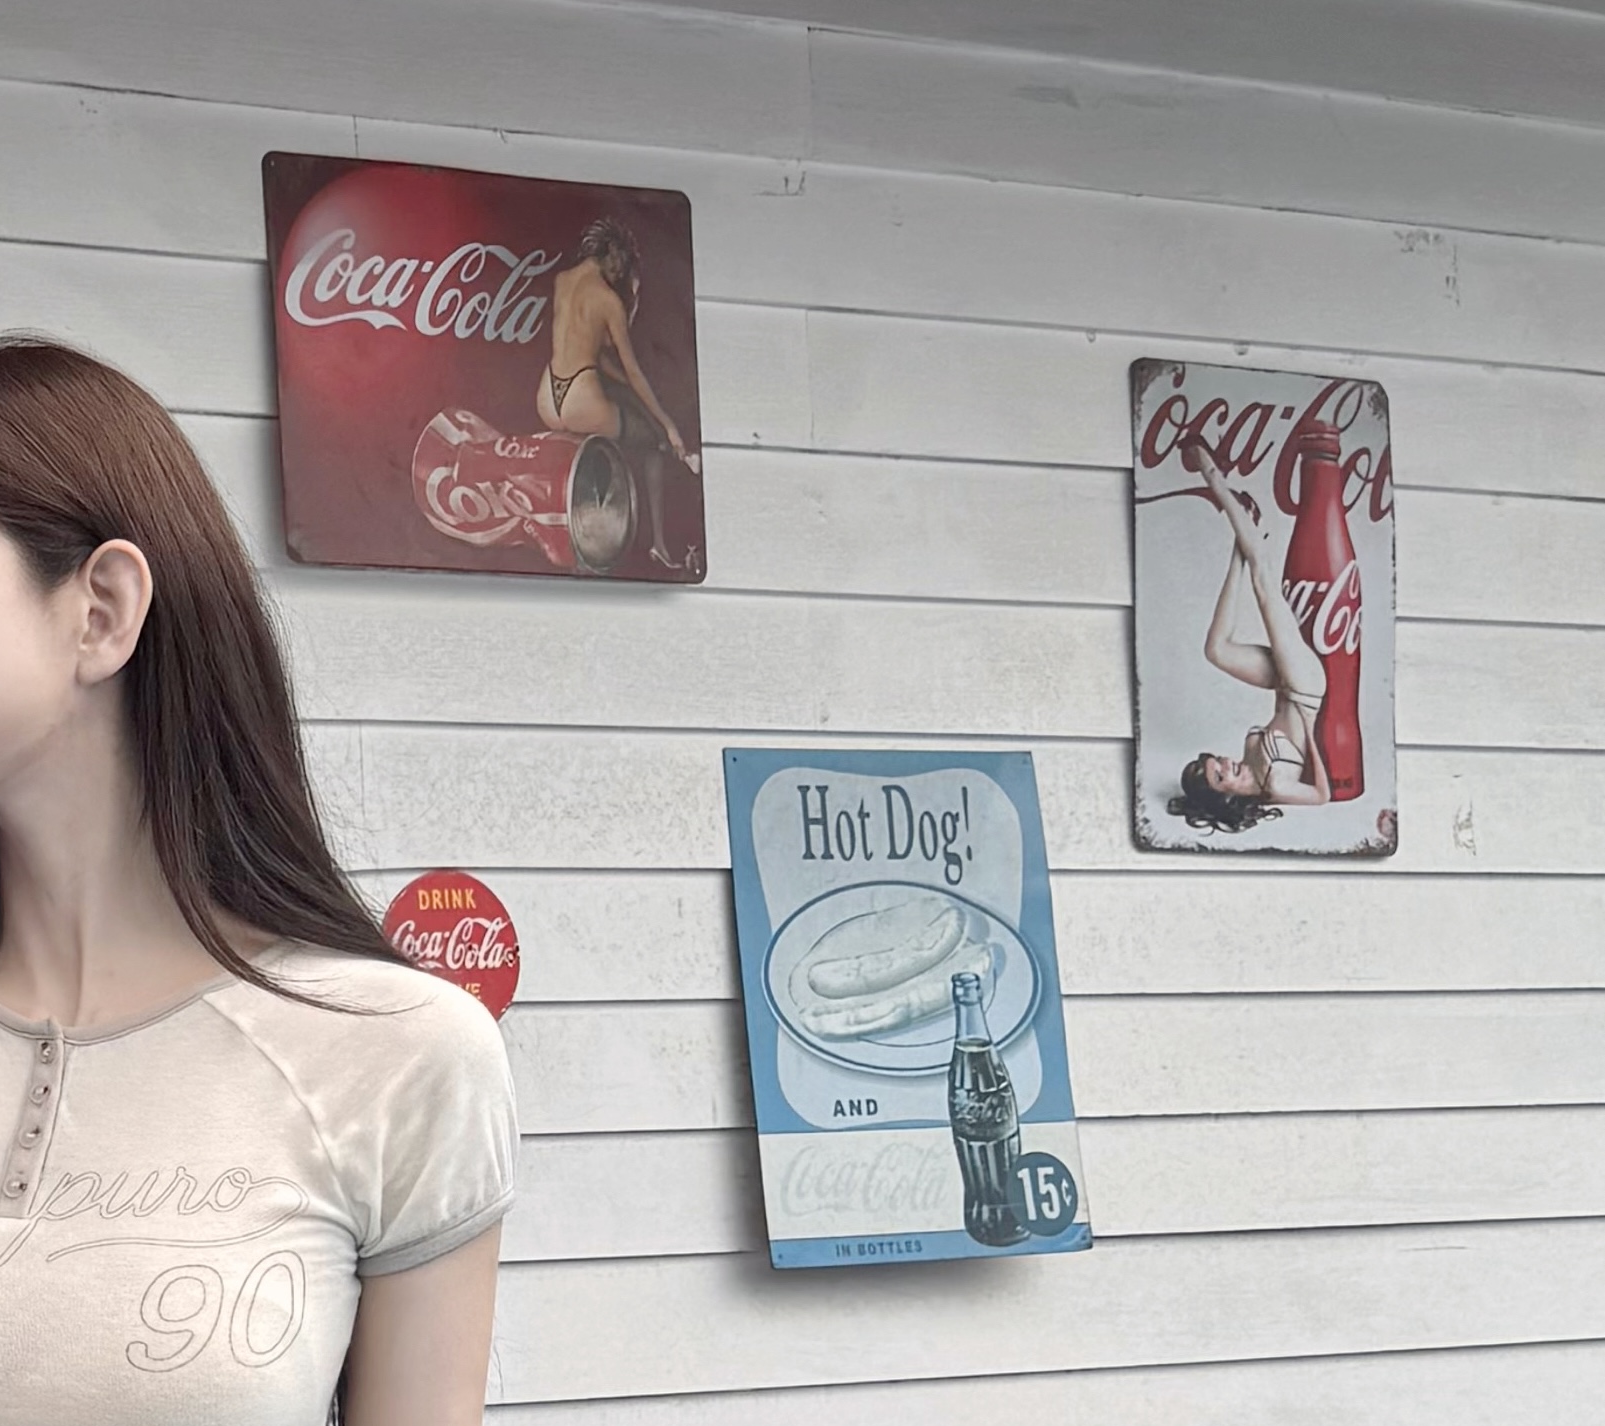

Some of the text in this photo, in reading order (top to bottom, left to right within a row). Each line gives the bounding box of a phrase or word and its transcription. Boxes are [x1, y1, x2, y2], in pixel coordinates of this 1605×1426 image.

[285, 228, 562, 343] Coca-Cola
[797, 785, 973, 886] Hot Dog!
[418, 888, 476, 910] DRINK
[392, 917, 511, 969] Coca-Cola
[833, 1099, 878, 1117] AND
[835, 1240, 923, 1257] IN BOTTLES
[126, 1250, 307, 1373] 90
